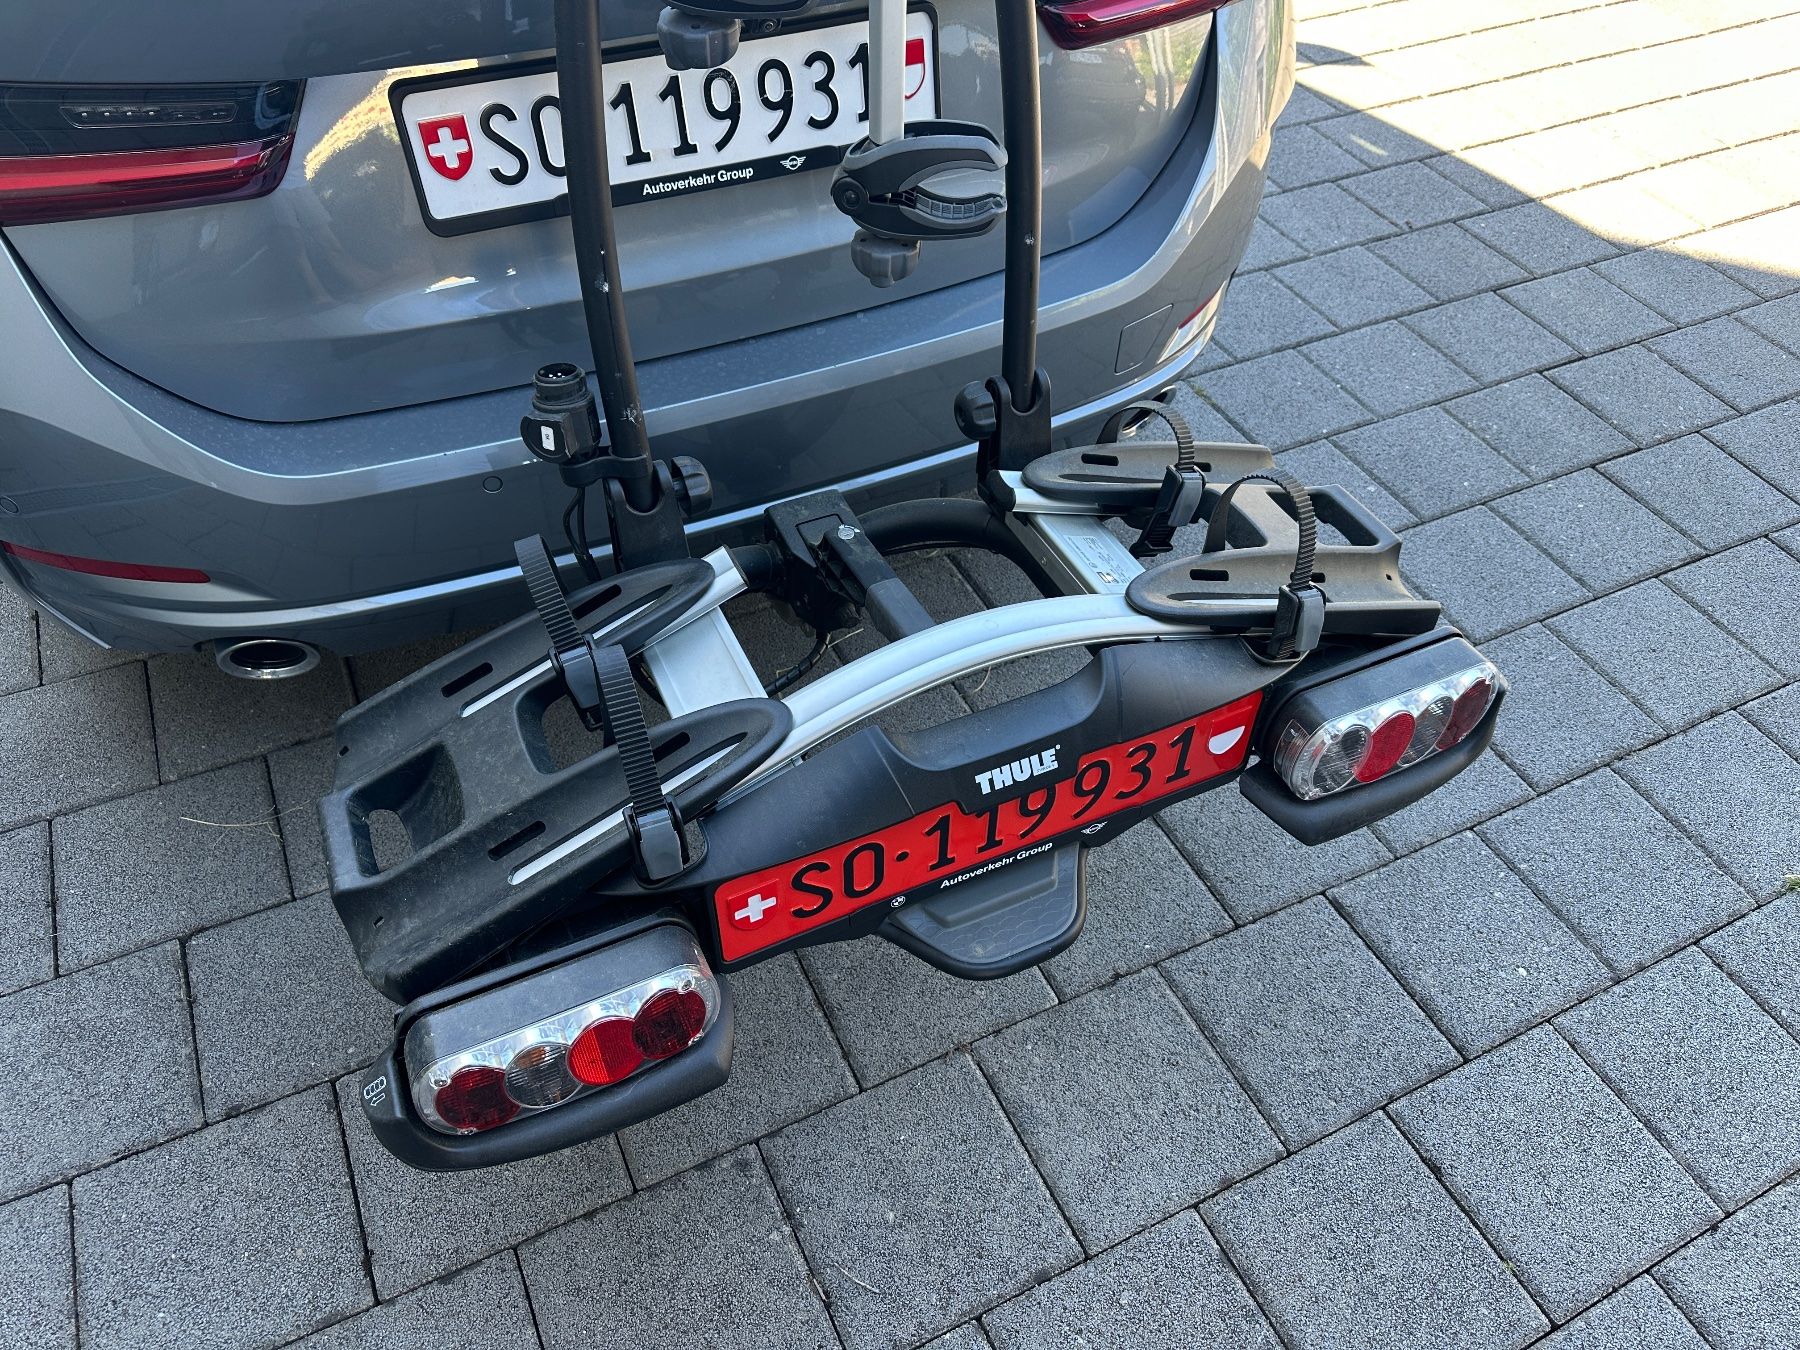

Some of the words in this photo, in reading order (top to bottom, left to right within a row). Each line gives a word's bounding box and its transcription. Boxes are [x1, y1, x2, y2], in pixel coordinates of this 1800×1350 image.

[642, 172, 716, 196] Autoverkehr
[717, 167, 754, 183] Group
[975, 747, 1059, 795] THULE
[940, 856, 1015, 889] Autoverkehr
[1016, 842, 1053, 860] Group
